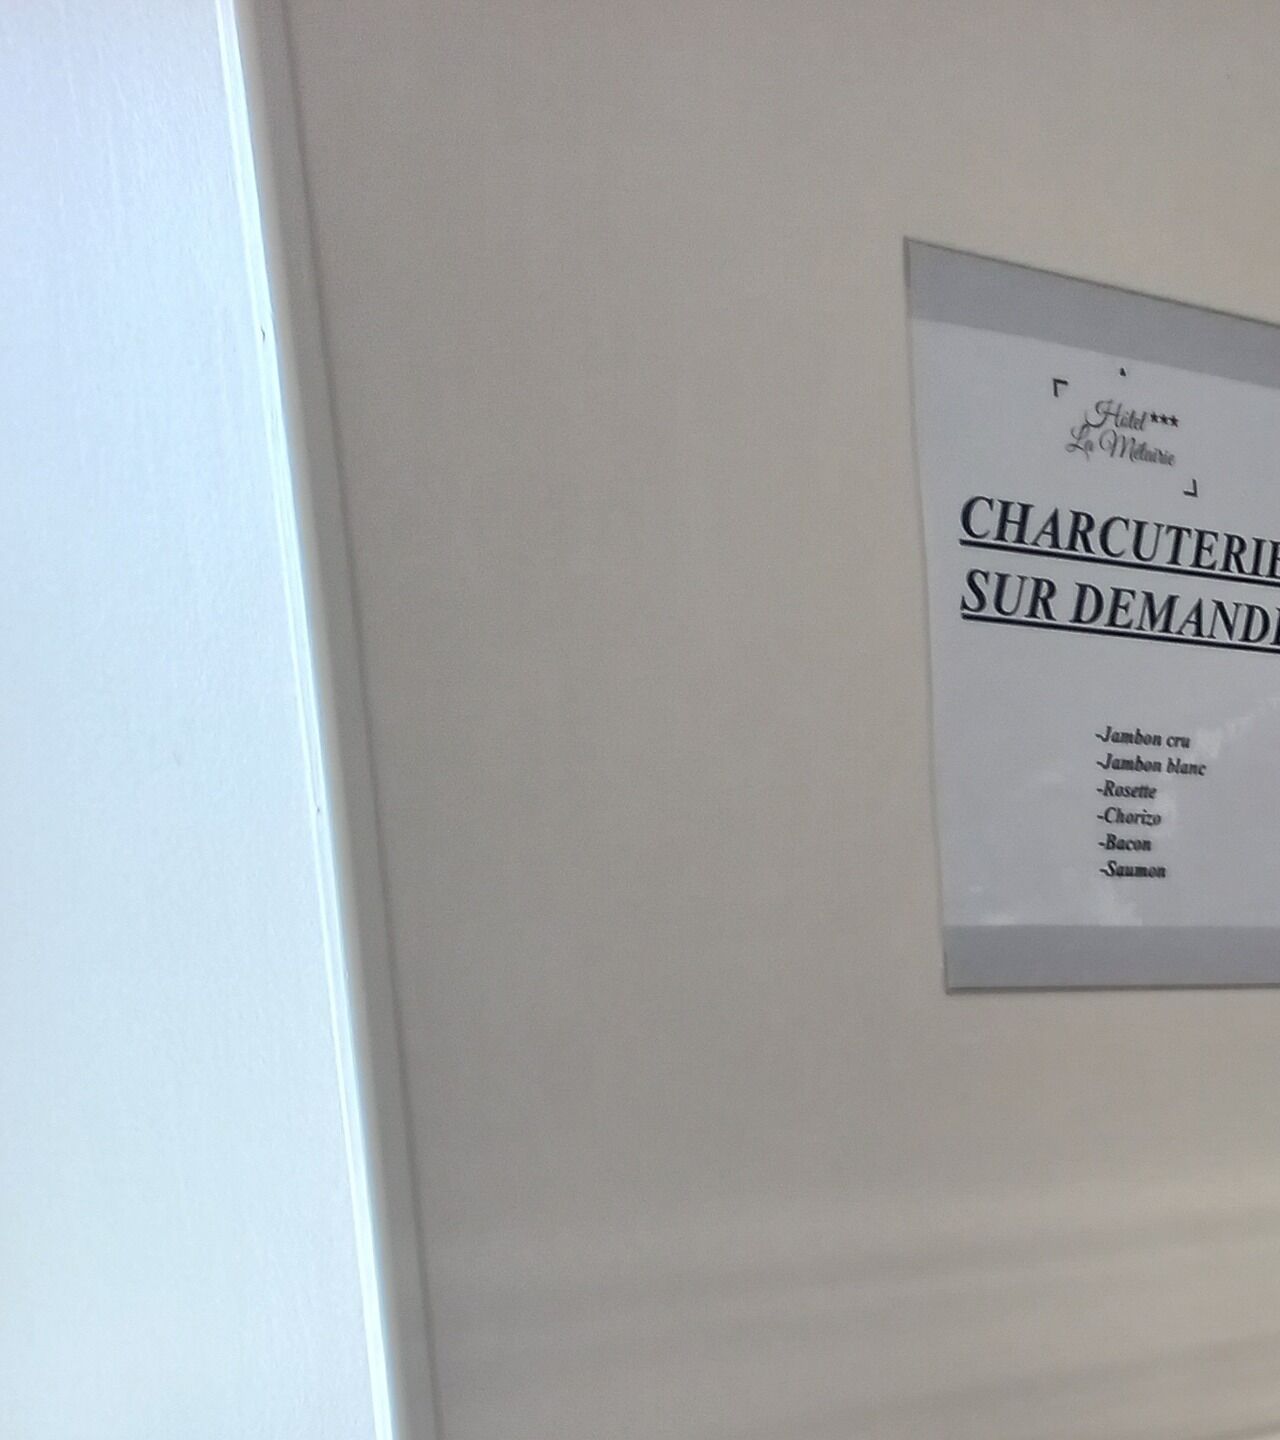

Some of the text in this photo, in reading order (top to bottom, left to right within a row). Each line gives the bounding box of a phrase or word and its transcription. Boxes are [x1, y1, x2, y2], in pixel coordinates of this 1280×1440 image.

[960, 568, 1058, 622] SUR
[1095, 726, 1190, 748] -Jambon cru
[1096, 753, 1207, 776] -Jambon blanc
[1096, 780, 1158, 799] -Rosette
[1097, 806, 1162, 826] -Chorizo
[1098, 833, 1152, 851] -Bacon
[1099, 860, 1167, 878] -Saumon
